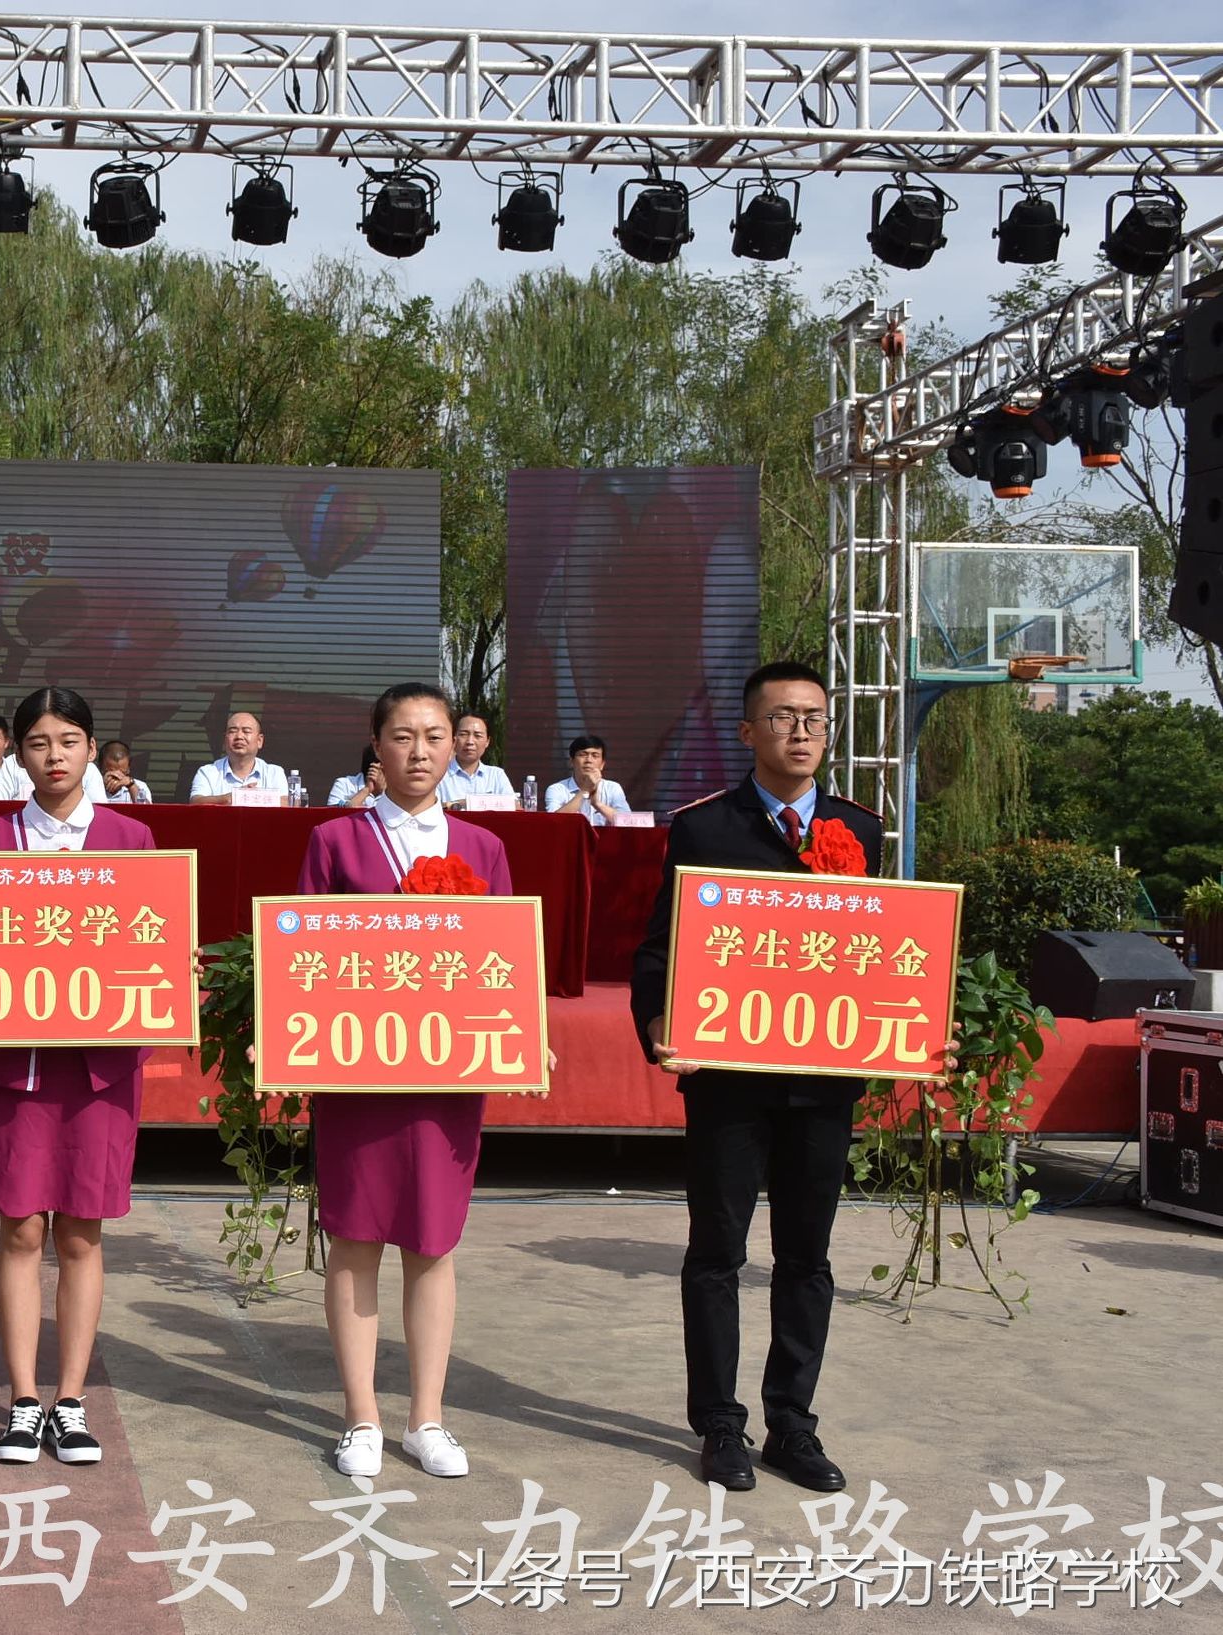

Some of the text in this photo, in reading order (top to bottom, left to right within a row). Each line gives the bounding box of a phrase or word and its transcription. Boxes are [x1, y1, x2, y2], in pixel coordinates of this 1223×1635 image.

[304, 913, 463, 932] 西安齐力铁路学校
[726, 887, 884, 914] 西安齐力铁路学校
[288, 950, 515, 992] 学生奖学金
[704, 924, 930, 978] 学生奖学金
[286, 1008, 526, 1078] 2000元
[694, 987, 930, 1063] 2000元
